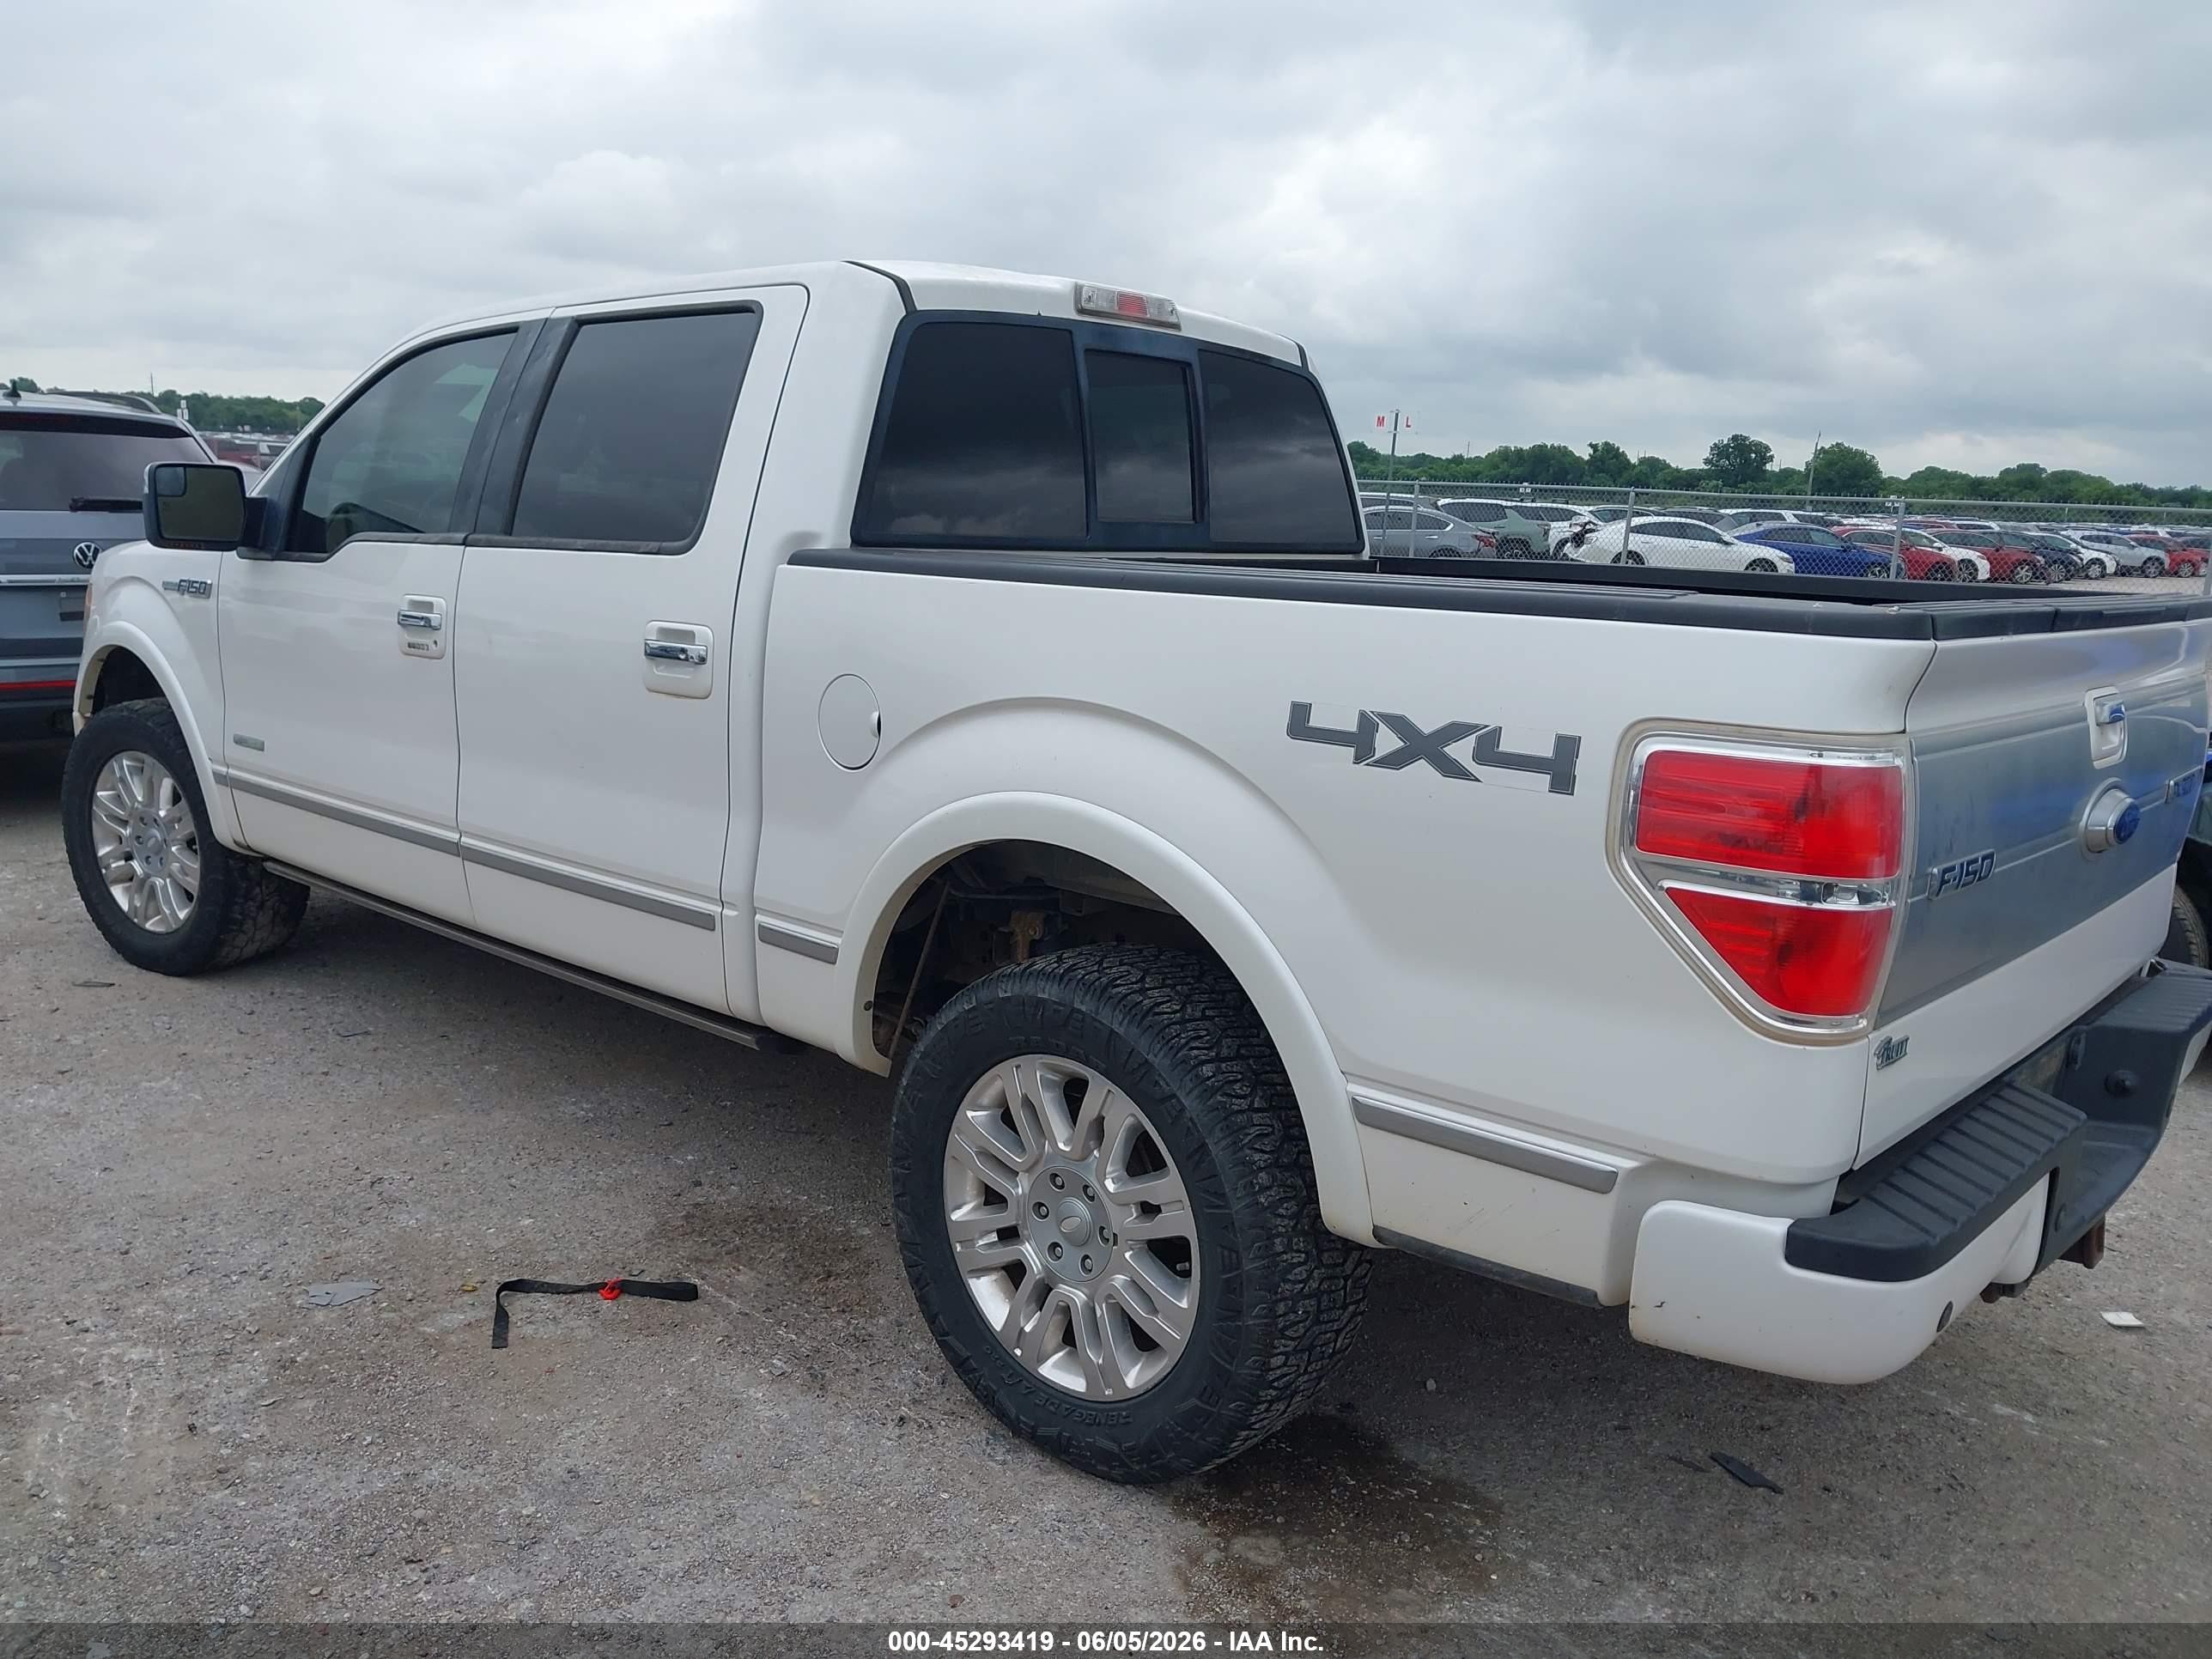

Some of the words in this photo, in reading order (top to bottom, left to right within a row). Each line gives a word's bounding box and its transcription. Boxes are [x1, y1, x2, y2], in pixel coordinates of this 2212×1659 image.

[1376, 416, 1385, 427] M
[1406, 416, 1412, 428] L
[1034, 1395, 1134, 1427] RENEGADE
